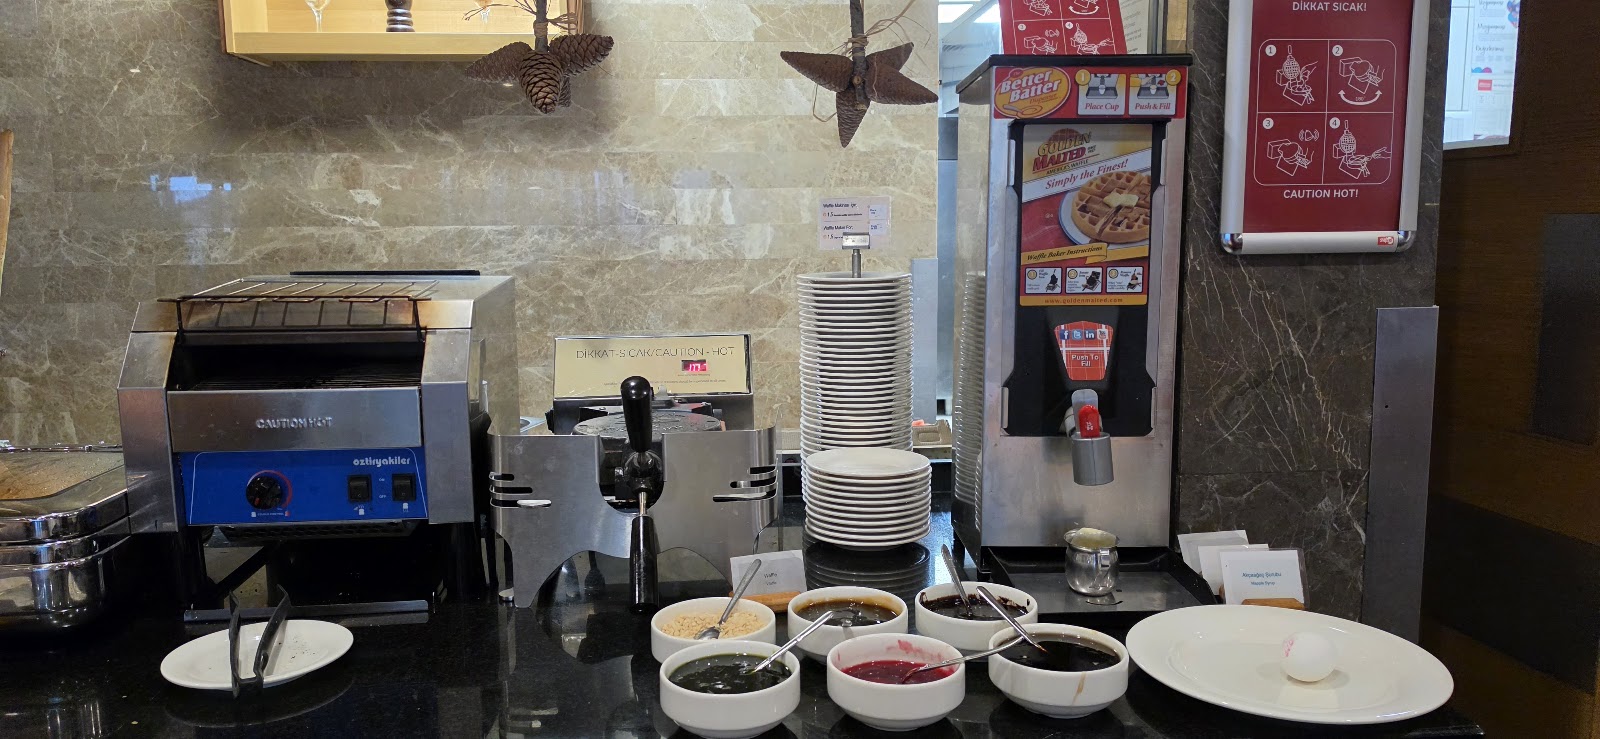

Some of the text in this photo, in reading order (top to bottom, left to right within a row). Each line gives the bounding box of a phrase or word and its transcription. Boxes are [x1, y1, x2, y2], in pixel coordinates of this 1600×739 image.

[1292, 0, 1367, 11] DİKKAT SICAK!
[1000, 70, 1053, 94] Better
[1010, 79, 1061, 103] Batter
[1084, 102, 1119, 111] Place Cup
[1135, 102, 1152, 110] Push
[1158, 102, 1171, 110] Fill
[1037, 131, 1092, 156] GOLDEN
[1032, 146, 1087, 172] MALTED
[1045, 158, 1129, 189] Simply the Finest!
[1283, 189, 1359, 199] CAUTION HOT!
[1027, 252, 1048, 261] Waffle
[1067, 245, 1103, 256] Instructions
[712, 346, 734, 356] HOT
[255, 416, 333, 429] CAUTION HOT
